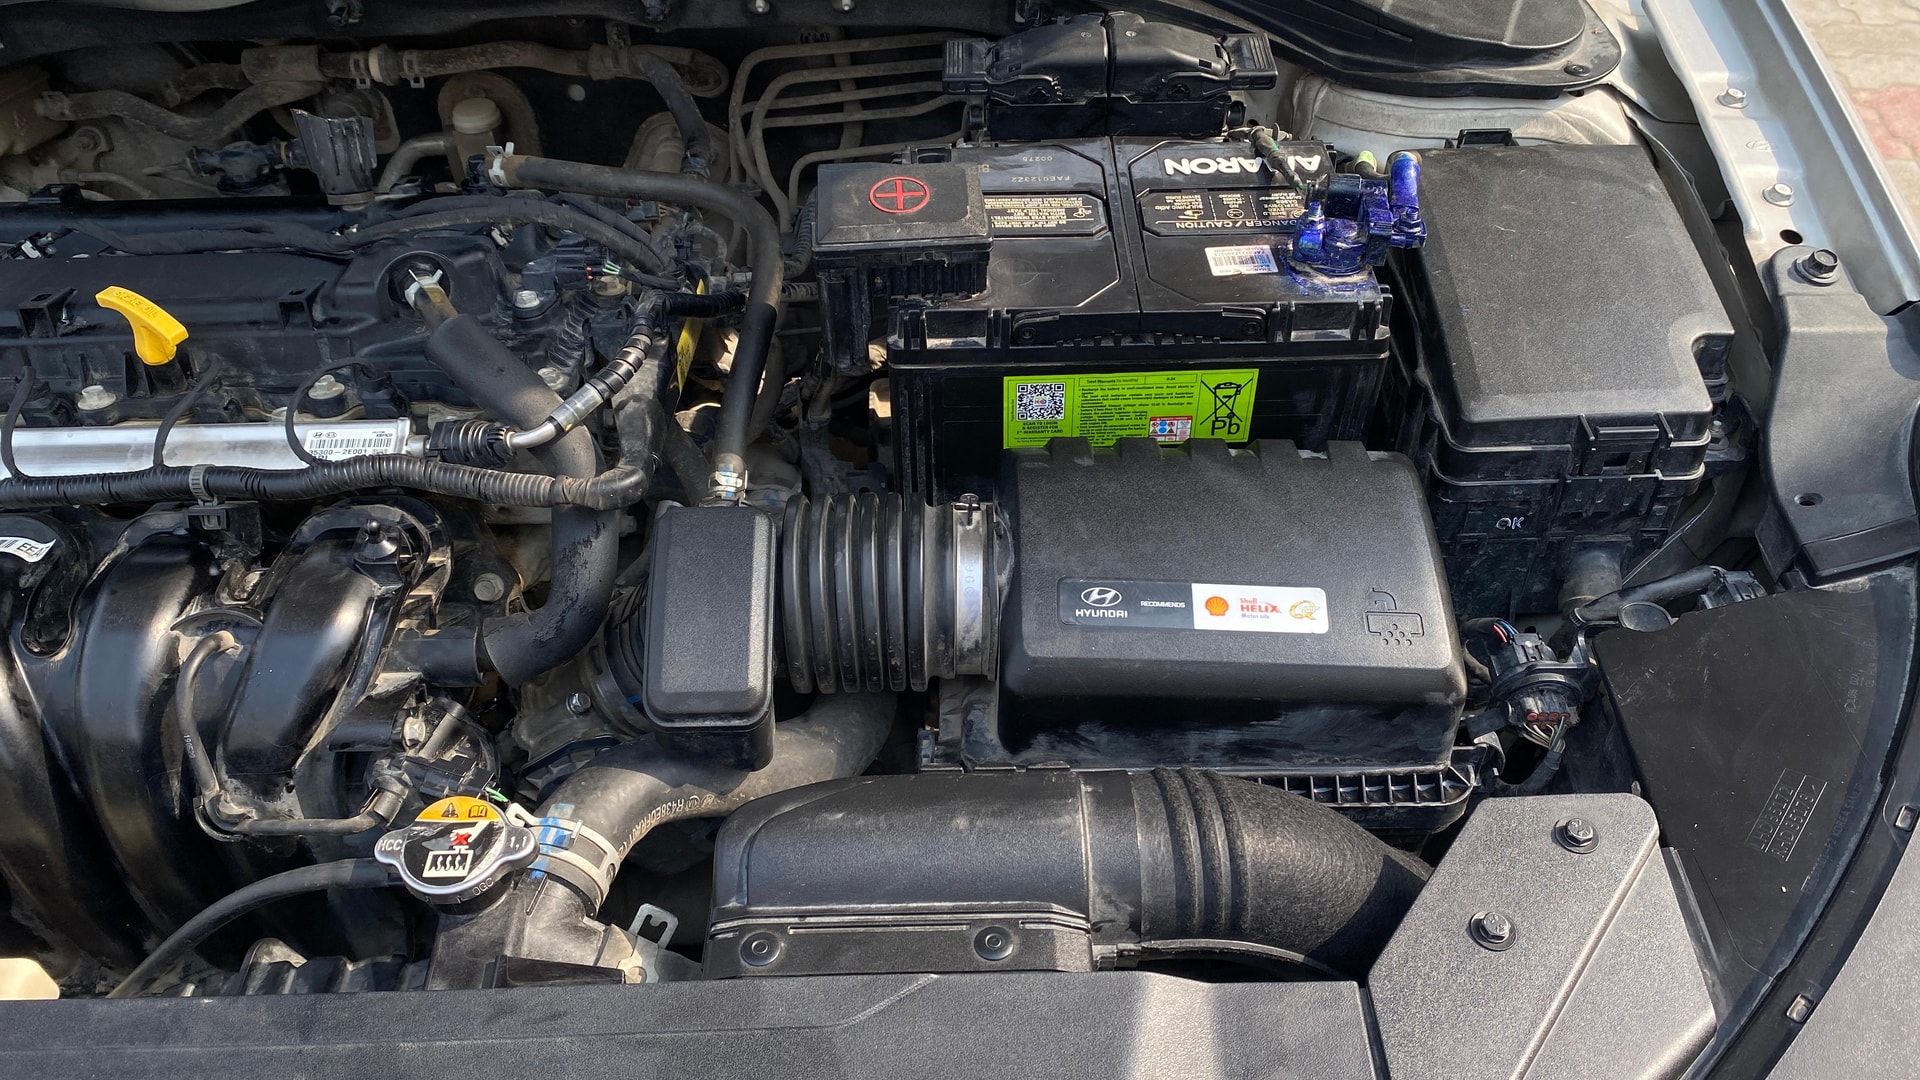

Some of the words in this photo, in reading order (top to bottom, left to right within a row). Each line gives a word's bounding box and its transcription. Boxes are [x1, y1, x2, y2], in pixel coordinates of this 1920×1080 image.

[1211, 418, 1240, 436] Pb
[1496, 516, 1524, 529] OK
[1075, 609, 1128, 618] HYUNDAI
[1240, 604, 1278, 614] HELIX
[378, 839, 402, 851] HCC
[510, 836, 526, 850] 1.1
